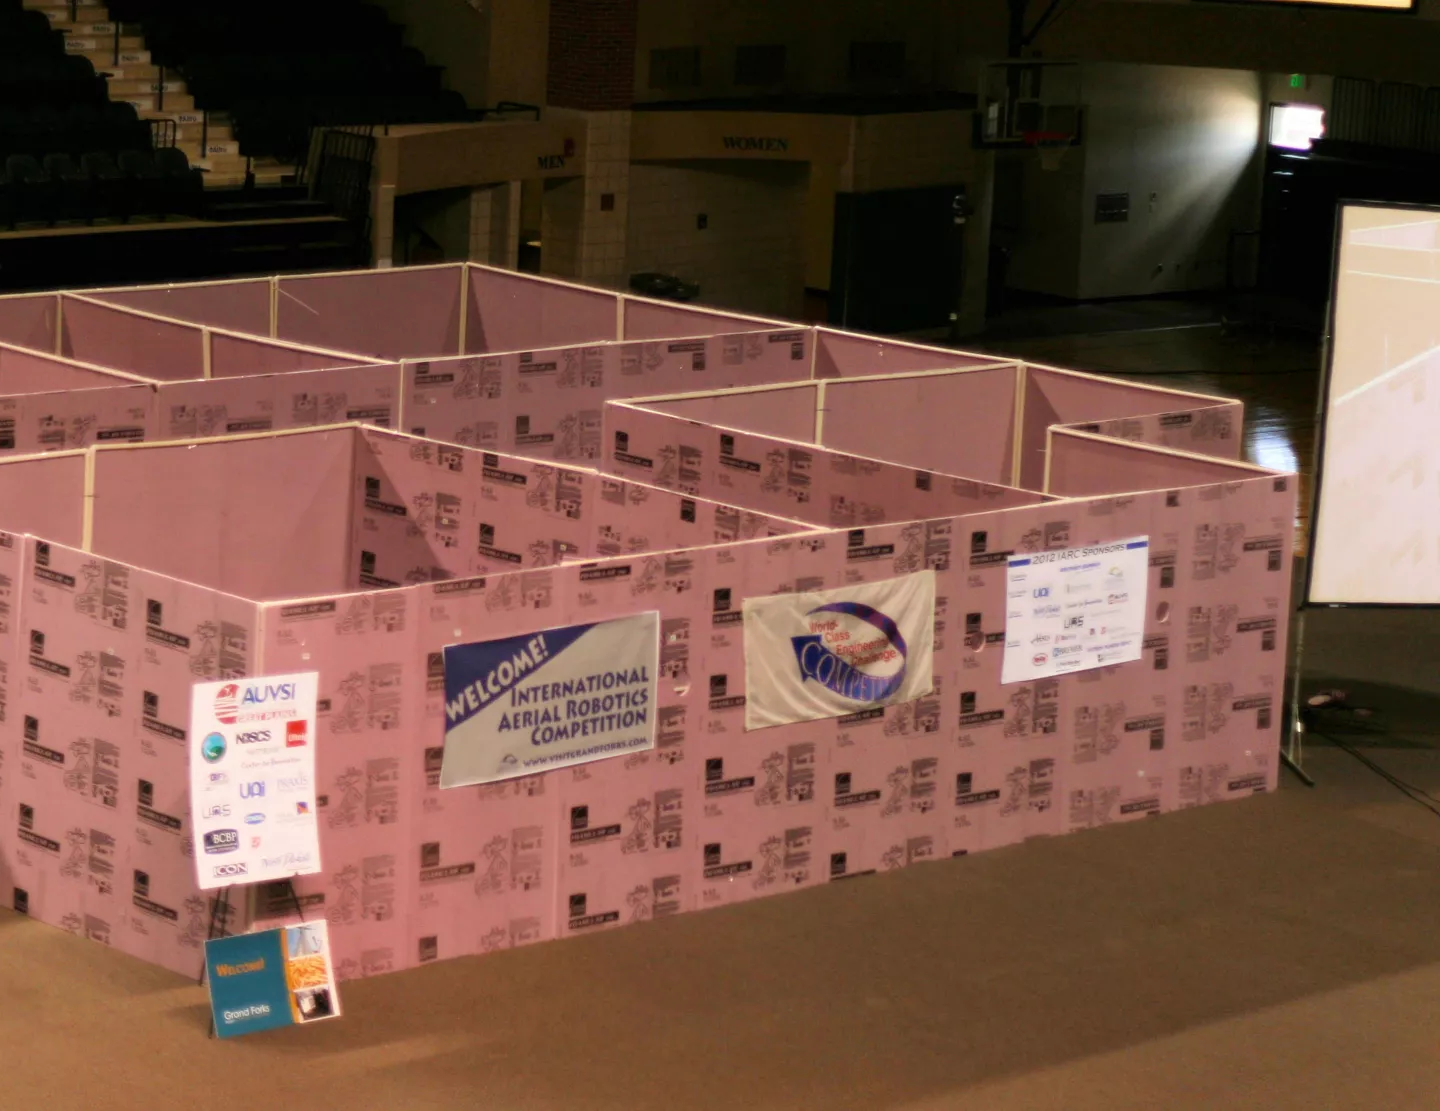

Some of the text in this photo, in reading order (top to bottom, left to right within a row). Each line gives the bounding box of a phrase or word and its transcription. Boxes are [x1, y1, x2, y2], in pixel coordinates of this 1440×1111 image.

[722, 136, 788, 151] WOMEN
[538, 155, 566, 169] MEN
[1032, 553, 1056, 565] 2012
[825, 631, 851, 643] Class
[446, 634, 550, 723] WELCOME!
[510, 665, 650, 708] INTERNATIONAL
[241, 683, 296, 704] AUVSI
[497, 688, 649, 733] AERIAL ROBOTICS
[530, 707, 648, 746] COMPETITION
[223, 1003, 271, 1020] Grand Forks
